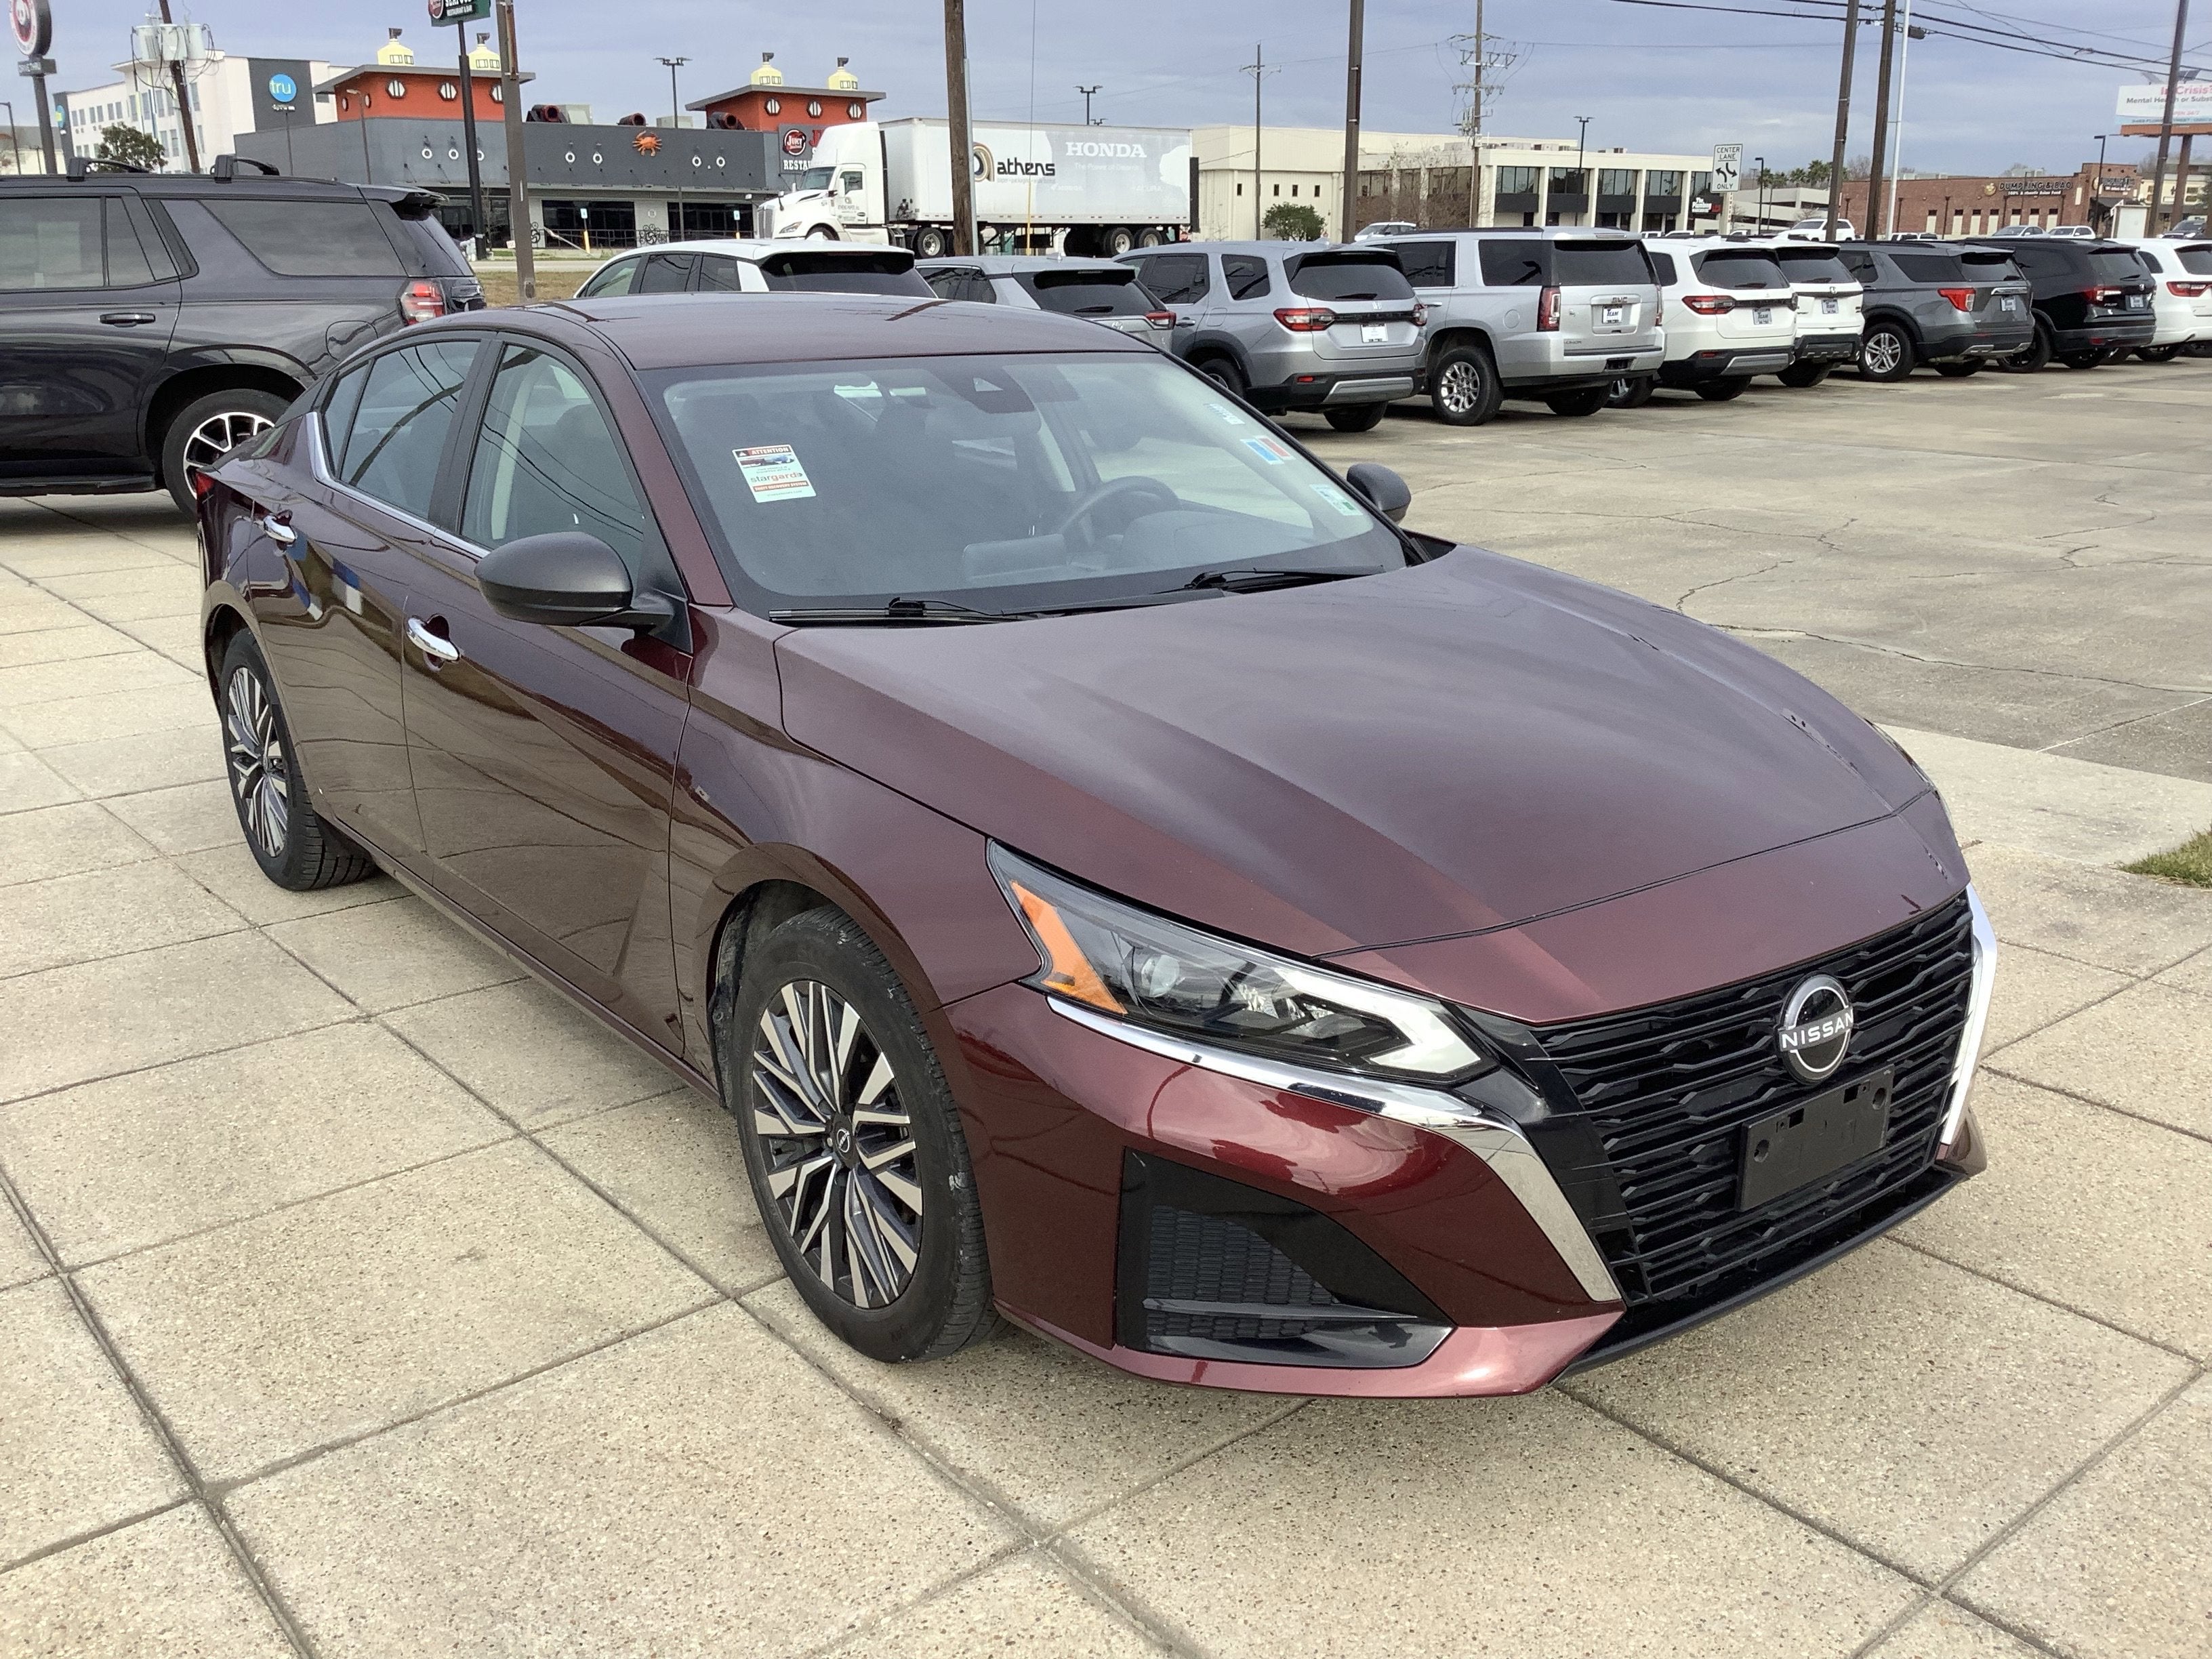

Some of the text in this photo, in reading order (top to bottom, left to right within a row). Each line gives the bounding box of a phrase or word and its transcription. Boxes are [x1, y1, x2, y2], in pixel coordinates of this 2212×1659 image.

[270, 80, 291, 94] tru
[1065, 142, 1147, 158] HONDA
[783, 160, 811, 170] RESTA
[997, 157, 1055, 176] athens
[2053, 181, 2072, 189] BAO
[752, 447, 789, 455] ATTENTION
[1782, 1008, 1854, 1048] NISSAN
